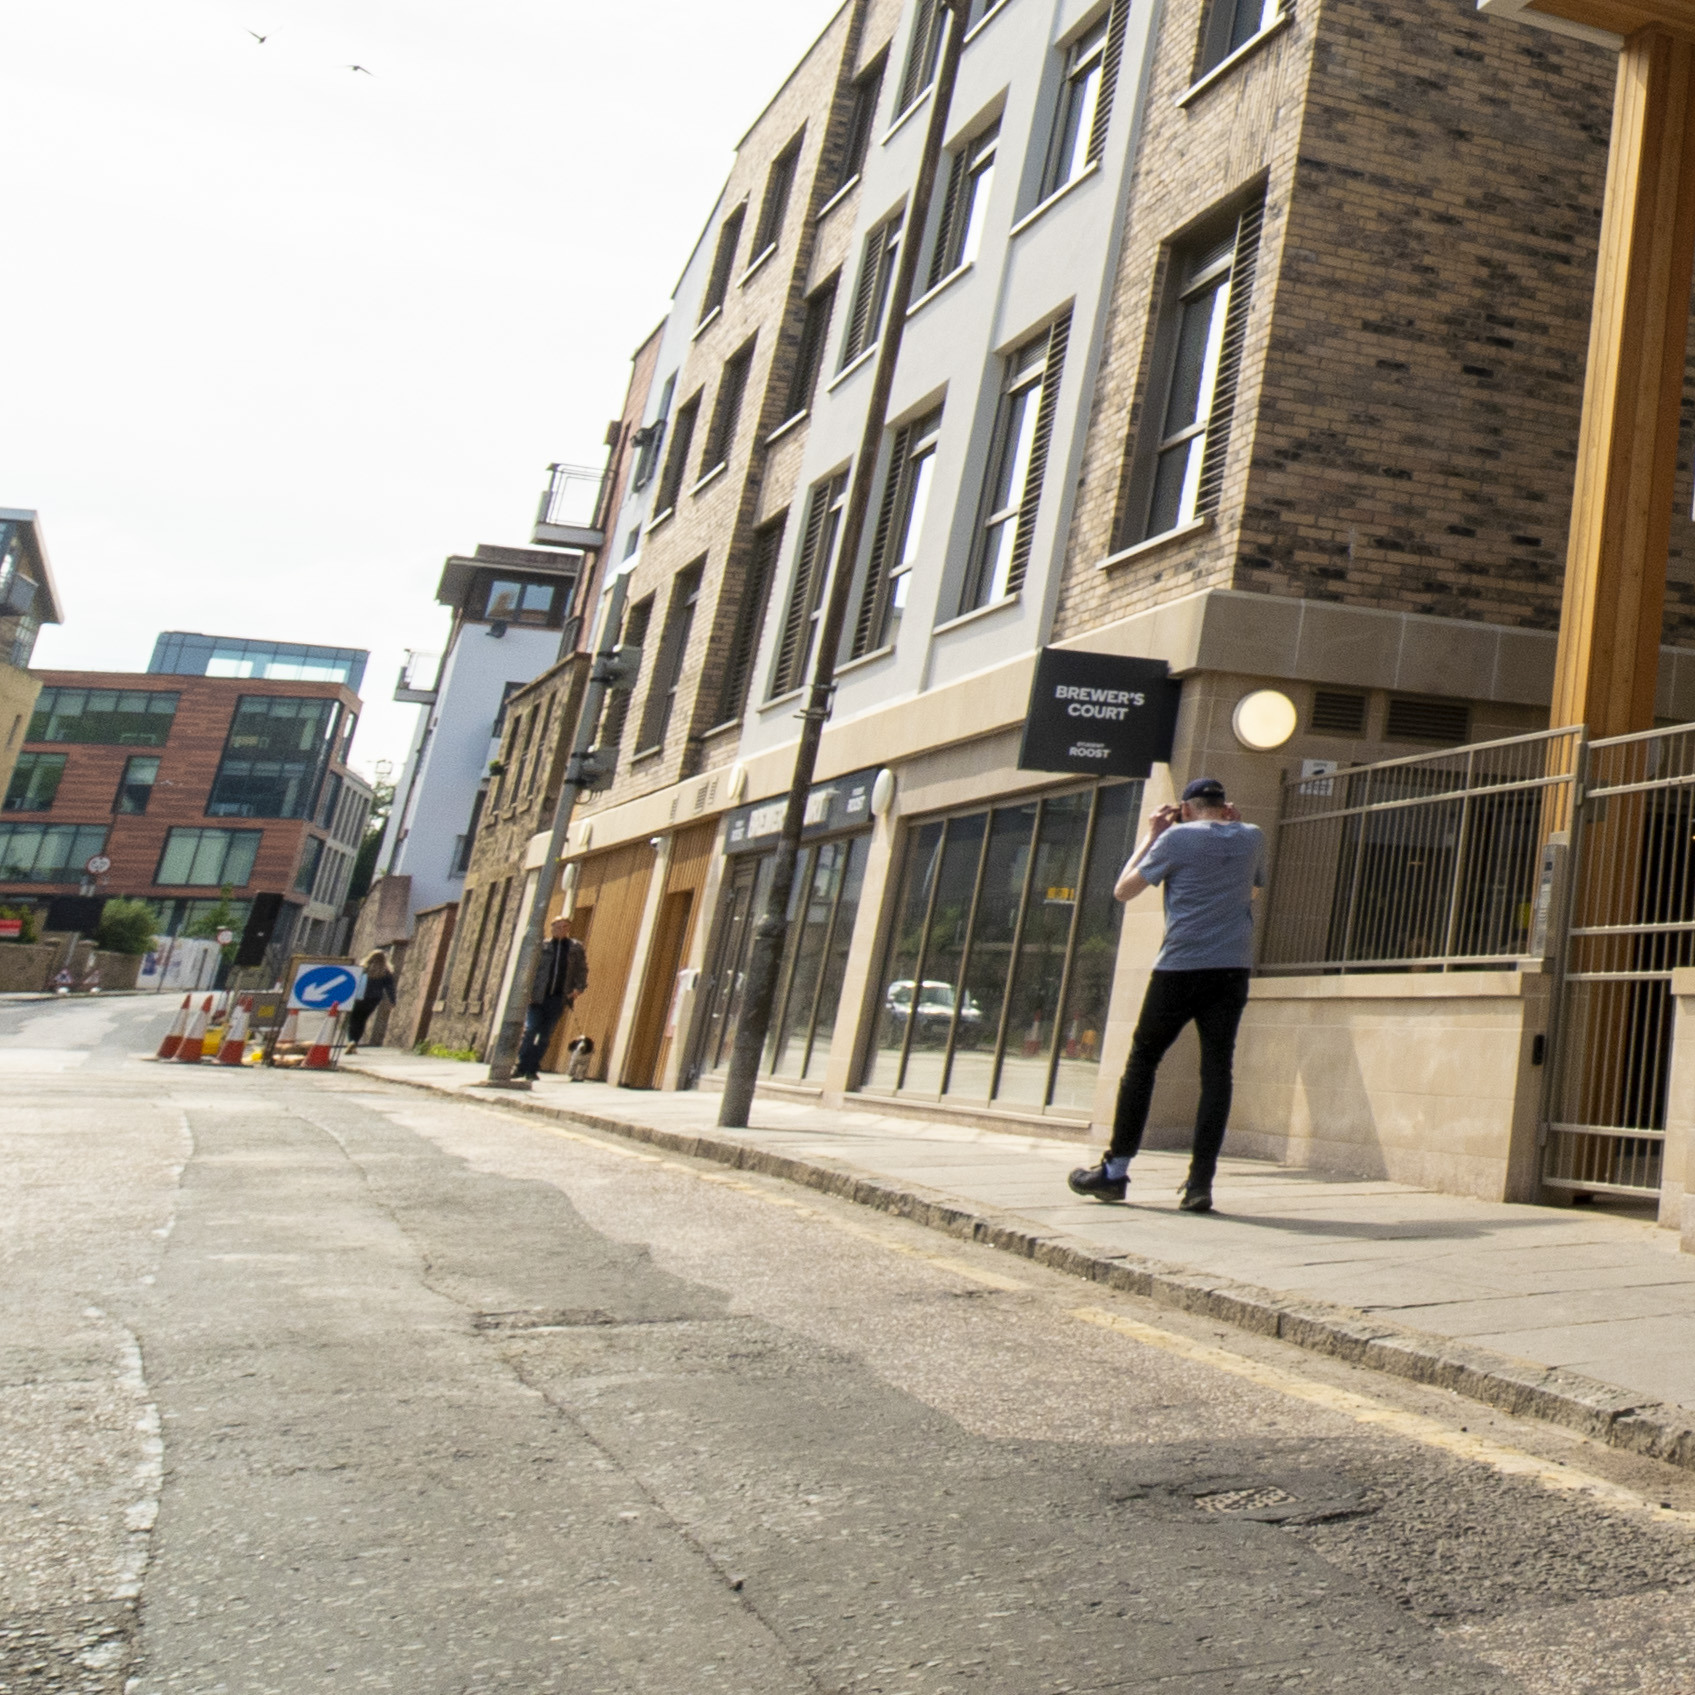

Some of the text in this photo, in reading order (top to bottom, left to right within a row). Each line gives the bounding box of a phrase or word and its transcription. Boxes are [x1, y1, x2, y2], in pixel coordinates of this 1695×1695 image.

[1055, 685, 1145, 706] BREWER'S
[1067, 702, 1129, 721] COURT
[1068, 746, 1111, 759] ROOST
